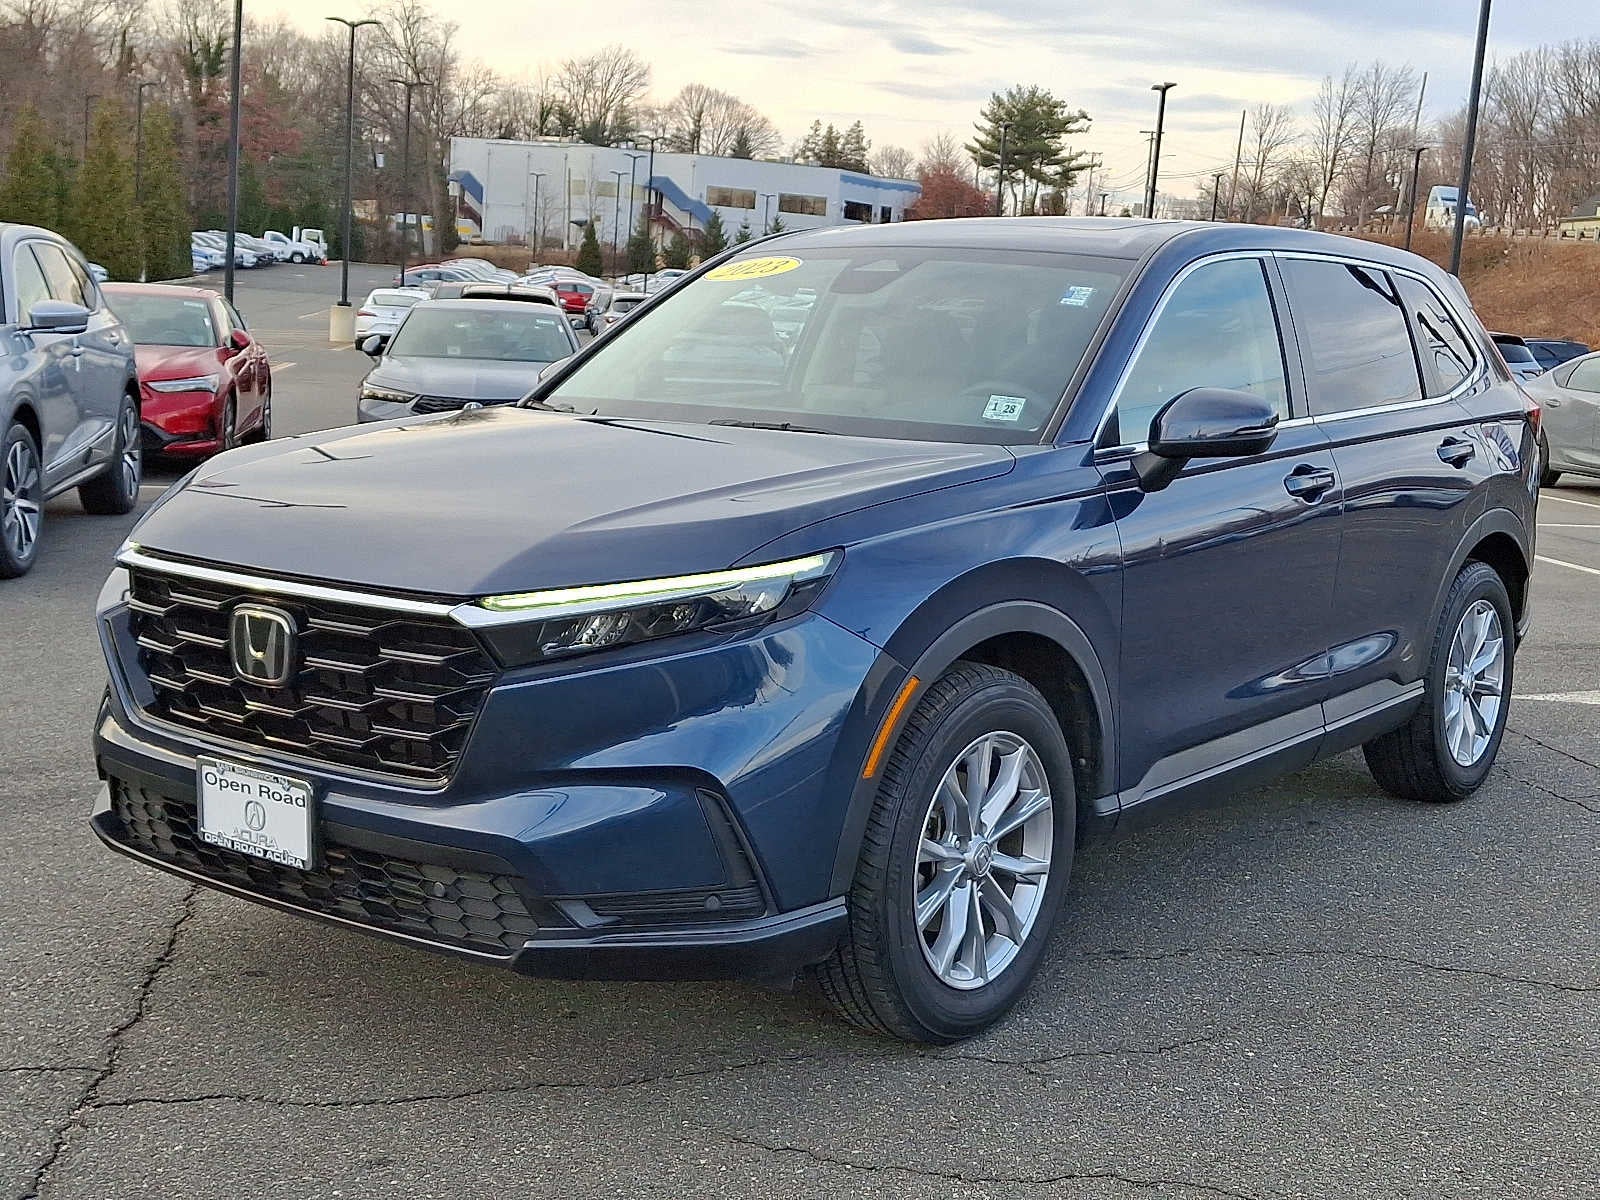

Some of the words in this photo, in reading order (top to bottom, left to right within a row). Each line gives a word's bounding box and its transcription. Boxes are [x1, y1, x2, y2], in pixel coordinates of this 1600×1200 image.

[1002, 404, 1016, 414] 28
[204, 771, 251, 794] Open
[258, 784, 306, 808] Road
[204, 832, 232, 849] OPEN
[233, 840, 264, 858] ROAD
[266, 849, 305, 870] ACURA
[231, 826, 279, 850] ACURA
